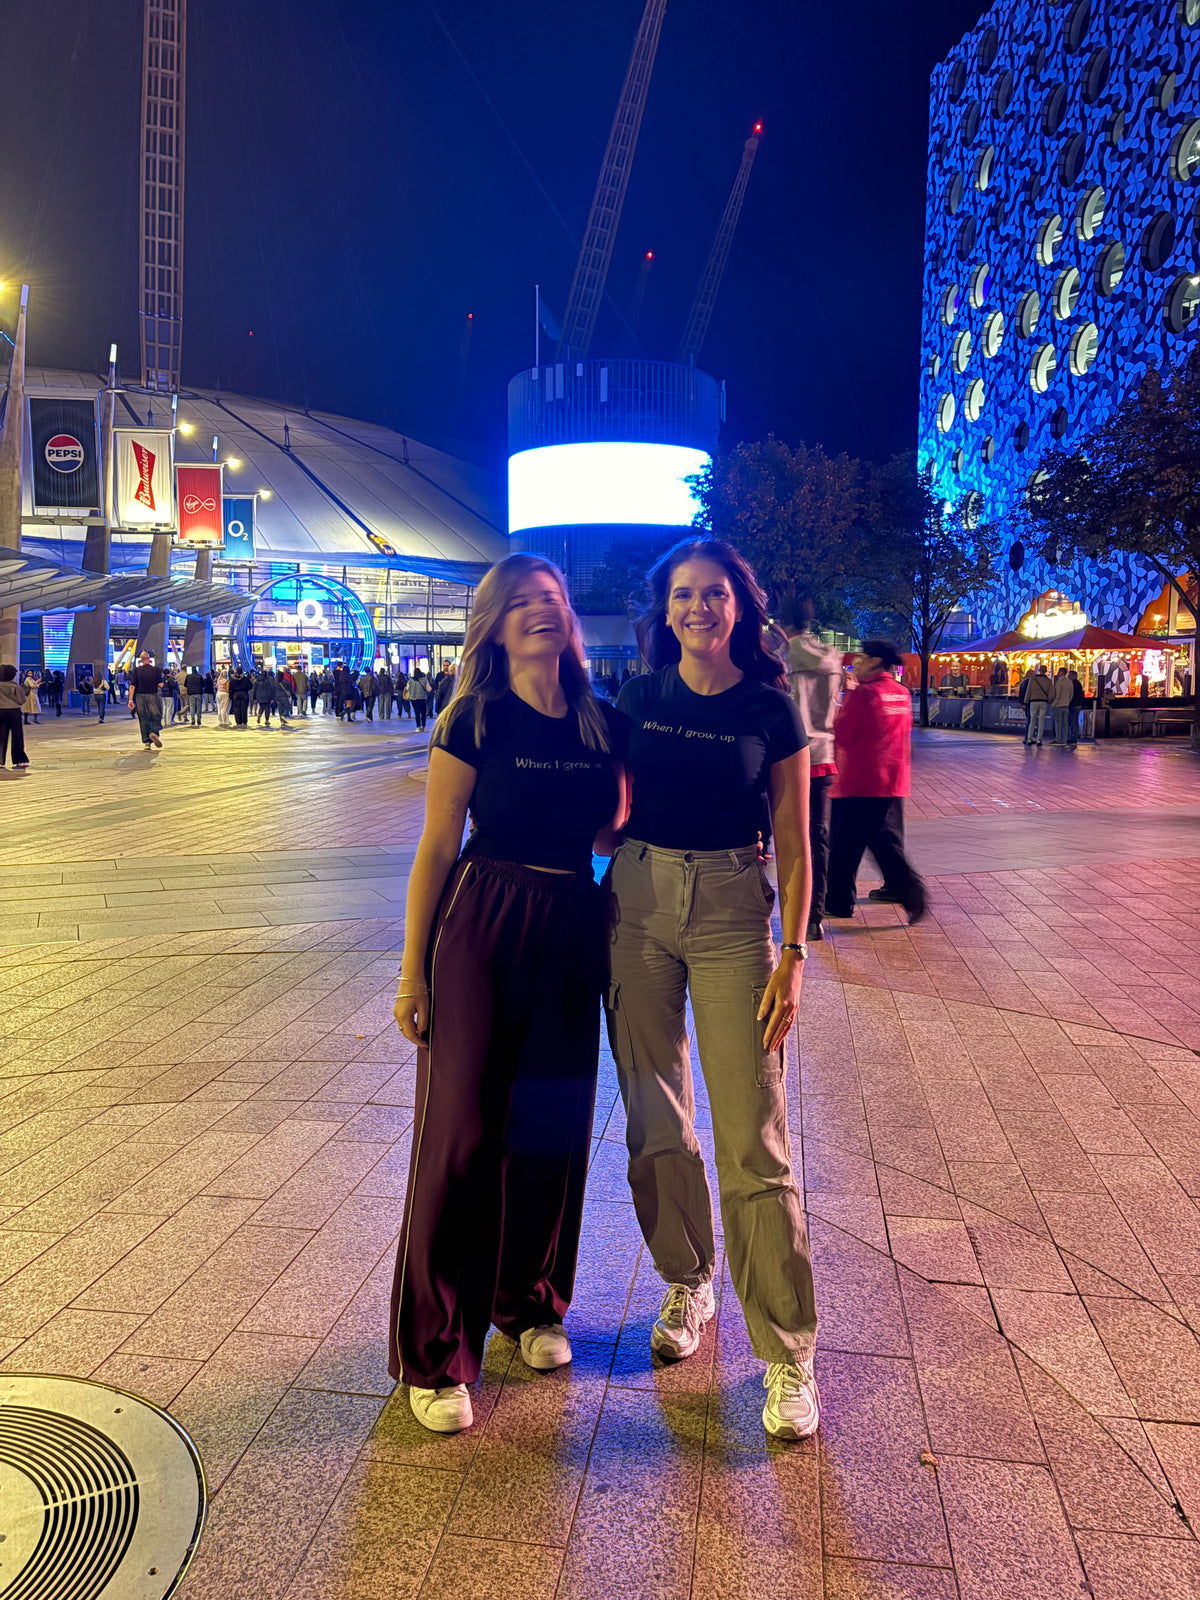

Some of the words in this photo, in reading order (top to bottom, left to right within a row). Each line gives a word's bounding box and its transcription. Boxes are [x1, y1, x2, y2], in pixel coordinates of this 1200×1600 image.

[47, 449, 82, 458] PEPSI
[139, 447, 151, 506] Budweiser
[642, 720, 674, 733] When
[677, 725, 683, 735] I
[684, 729, 717, 740] grow
[719, 735, 736, 744] up
[515, 757, 552, 769] When
[563, 761, 591, 772] grow
